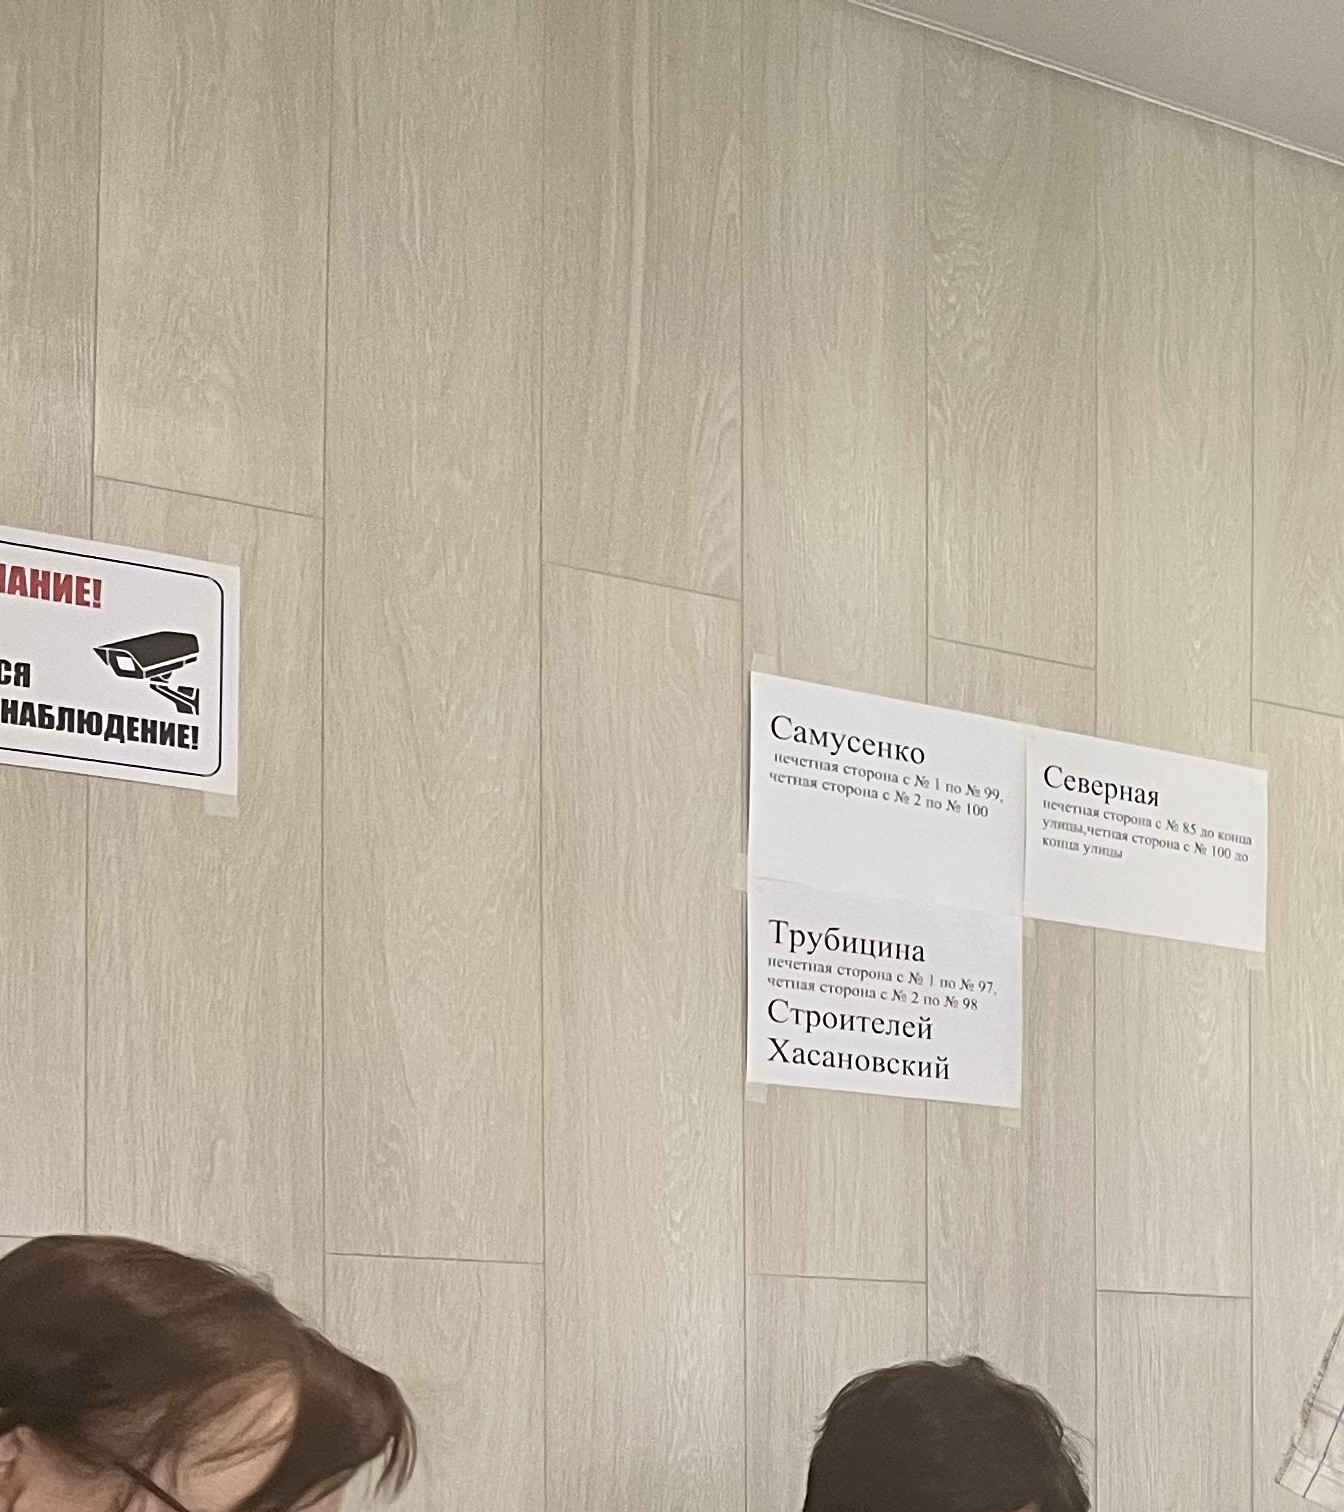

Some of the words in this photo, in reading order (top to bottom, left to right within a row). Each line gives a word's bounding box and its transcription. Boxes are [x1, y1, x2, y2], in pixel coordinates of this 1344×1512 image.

[0, 563, 102, 609] АНИЕ!
[770, 715, 926, 765] Самусенко
[769, 772, 818, 789] четная
[822, 781, 879, 799] сторона
[882, 791, 890, 801] с
[894, 790, 910, 805] №
[913, 793, 921, 806] 2
[925, 799, 942, 810] по
[945, 799, 962, 814] №
[967, 803, 988, 817] 100
[774, 753, 839, 773] нечетная
[843, 765, 899, 783] сторона
[903, 775, 911, 786] с
[914, 774, 930, 789] №
[945, 783, 962, 795] по
[965, 784, 981, 798] №
[1044, 765, 1160, 807] Северная
[1043, 799, 1100, 818] нечетная
[1104, 811, 1152, 828] сторона
[1183, 821, 1197, 835] 85
[1218, 831, 1252, 845] конца
[1042, 837, 1080, 852] конца
[1132, 834, 1180, 851] сторона
[1212, 845, 1232, 859] 100
[768, 919, 926, 963] Трубицина
[767, 977, 815, 991] четная
[819, 983, 876, 999] сторона
[880, 990, 887, 1000] с
[891, 989, 907, 1003] №
[911, 991, 919, 1004] 2
[923, 995, 940, 1006] по
[943, 995, 959, 1009] №
[962, 997, 978, 1011] 98
[768, 957, 832, 974] нечетная
[837, 965, 892, 982] сторона
[897, 973, 904, 983] с
[908, 971, 924, 986] №
[939, 979, 956, 989] по
[959, 978, 975, 992] №
[767, 998, 933, 1040] Строителей
[767, 1037, 950, 1080] Хасановский
